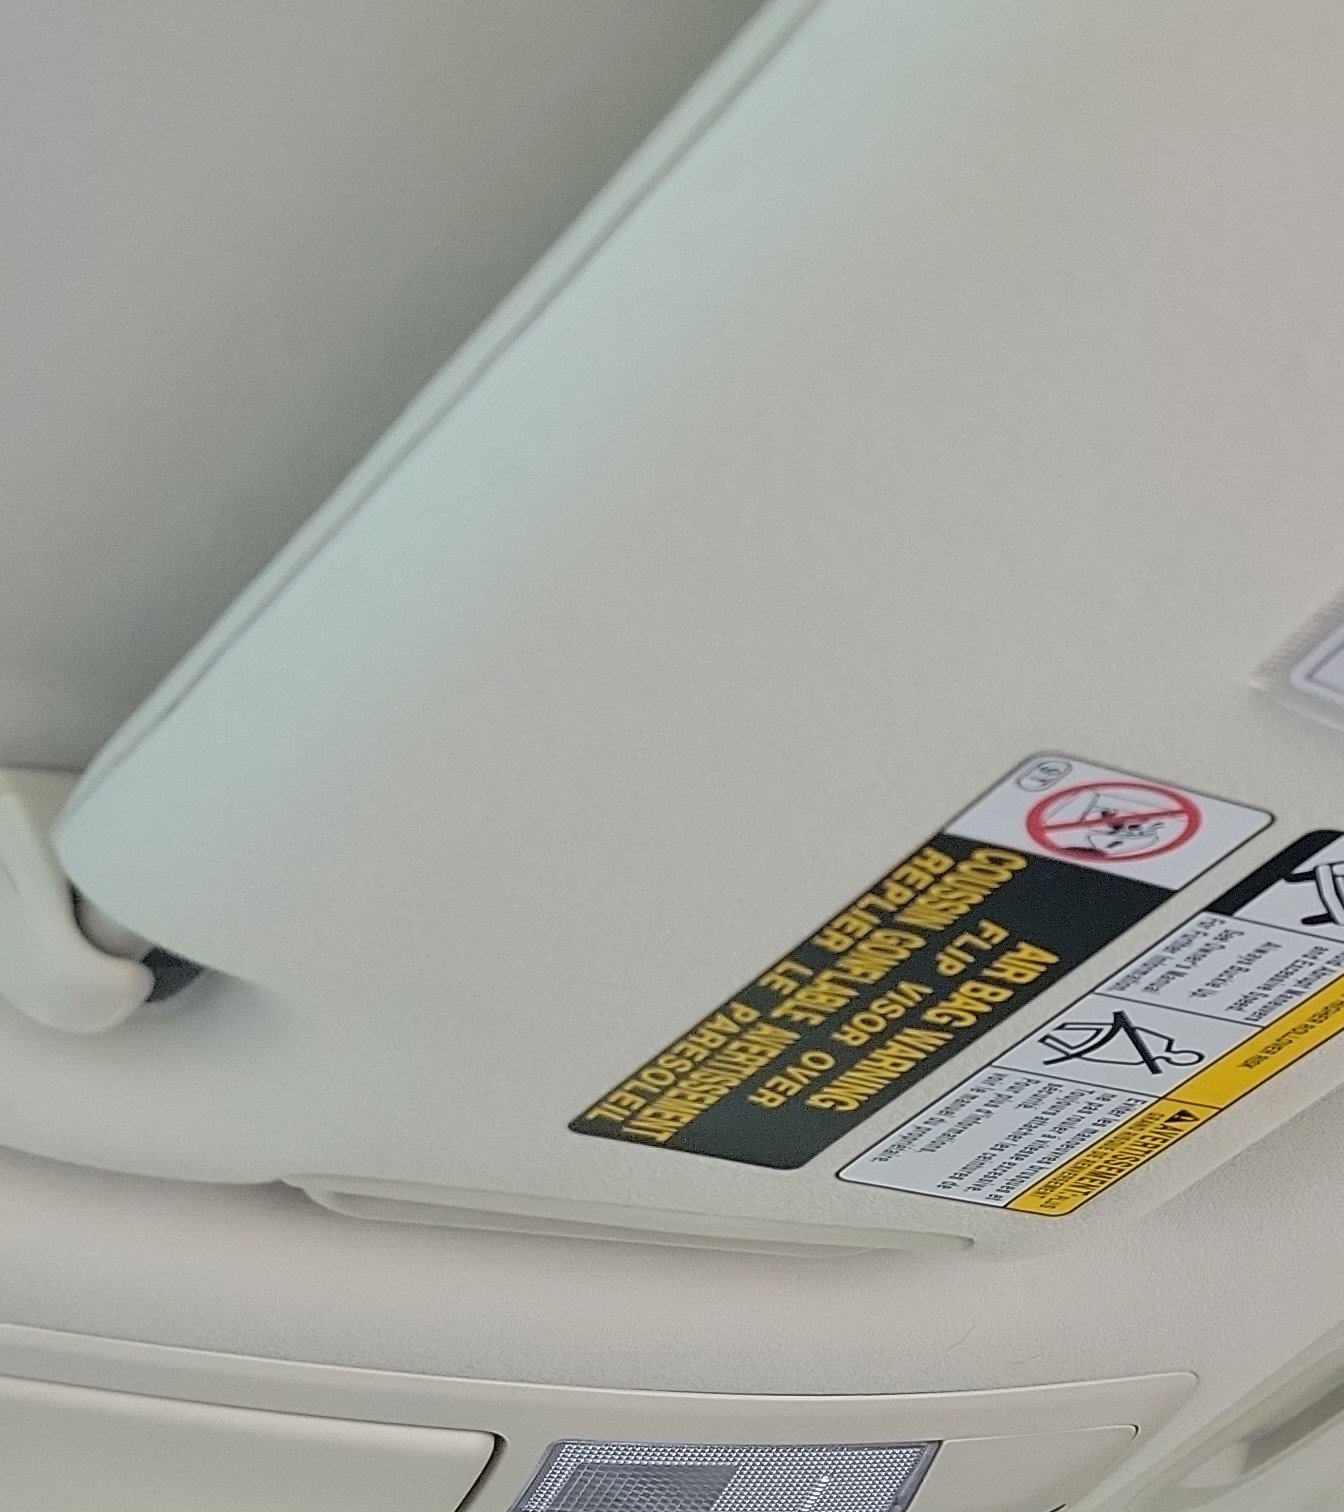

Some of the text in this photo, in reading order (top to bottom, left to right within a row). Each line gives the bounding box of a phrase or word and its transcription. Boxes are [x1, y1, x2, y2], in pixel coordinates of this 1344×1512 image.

[1162, 930, 1208, 954] Further
[1236, 941, 1281, 965] Always
[587, 848, 952, 1120] REPLIER LE PARESOLEIL
[1142, 969, 1187, 992] Manual
[1256, 958, 1314, 991] Excessive
[1293, 965, 1335, 989] Abrupt
[624, 849, 1025, 1140] COUSSIN GONFLABLE AVERTISSEMENT
[1243, 988, 1305, 1022] Maneuvers
[748, 920, 1008, 1107] FLIP VISOR OVER
[1308, 1000, 1344, 1024] HIGHER
[807, 942, 1058, 1110] AIR BAG WARNING
[1259, 1023, 1315, 1055] ROLLOVER
[1237, 1054, 1269, 1069] RISK
[981, 1072, 1008, 1086] voir
[1005, 1077, 1041, 1094] Pour
[937, 1093, 978, 1116] manuel
[982, 1092, 1013, 1108] plus
[1040, 1088, 1095, 1116] Toujours
[1076, 1101, 1103, 1114] pas
[1005, 1115, 1049, 1142] attacher
[1049, 1114, 1085, 1134] rouler
[1127, 1111, 1165, 1131] GRAND
[1009, 1139, 1049, 1161] vitesse
[1036, 1128, 1098, 1164] manoeuvres
[1097, 1131, 1138, 1151] RISQUE
[948, 1151, 997, 1180] ceintures
[995, 1164, 1049, 1193] brusques
[1031, 1158, 1096, 1199] RENVERSEMENT
[1038, 1194, 1070, 1209] PLUS
